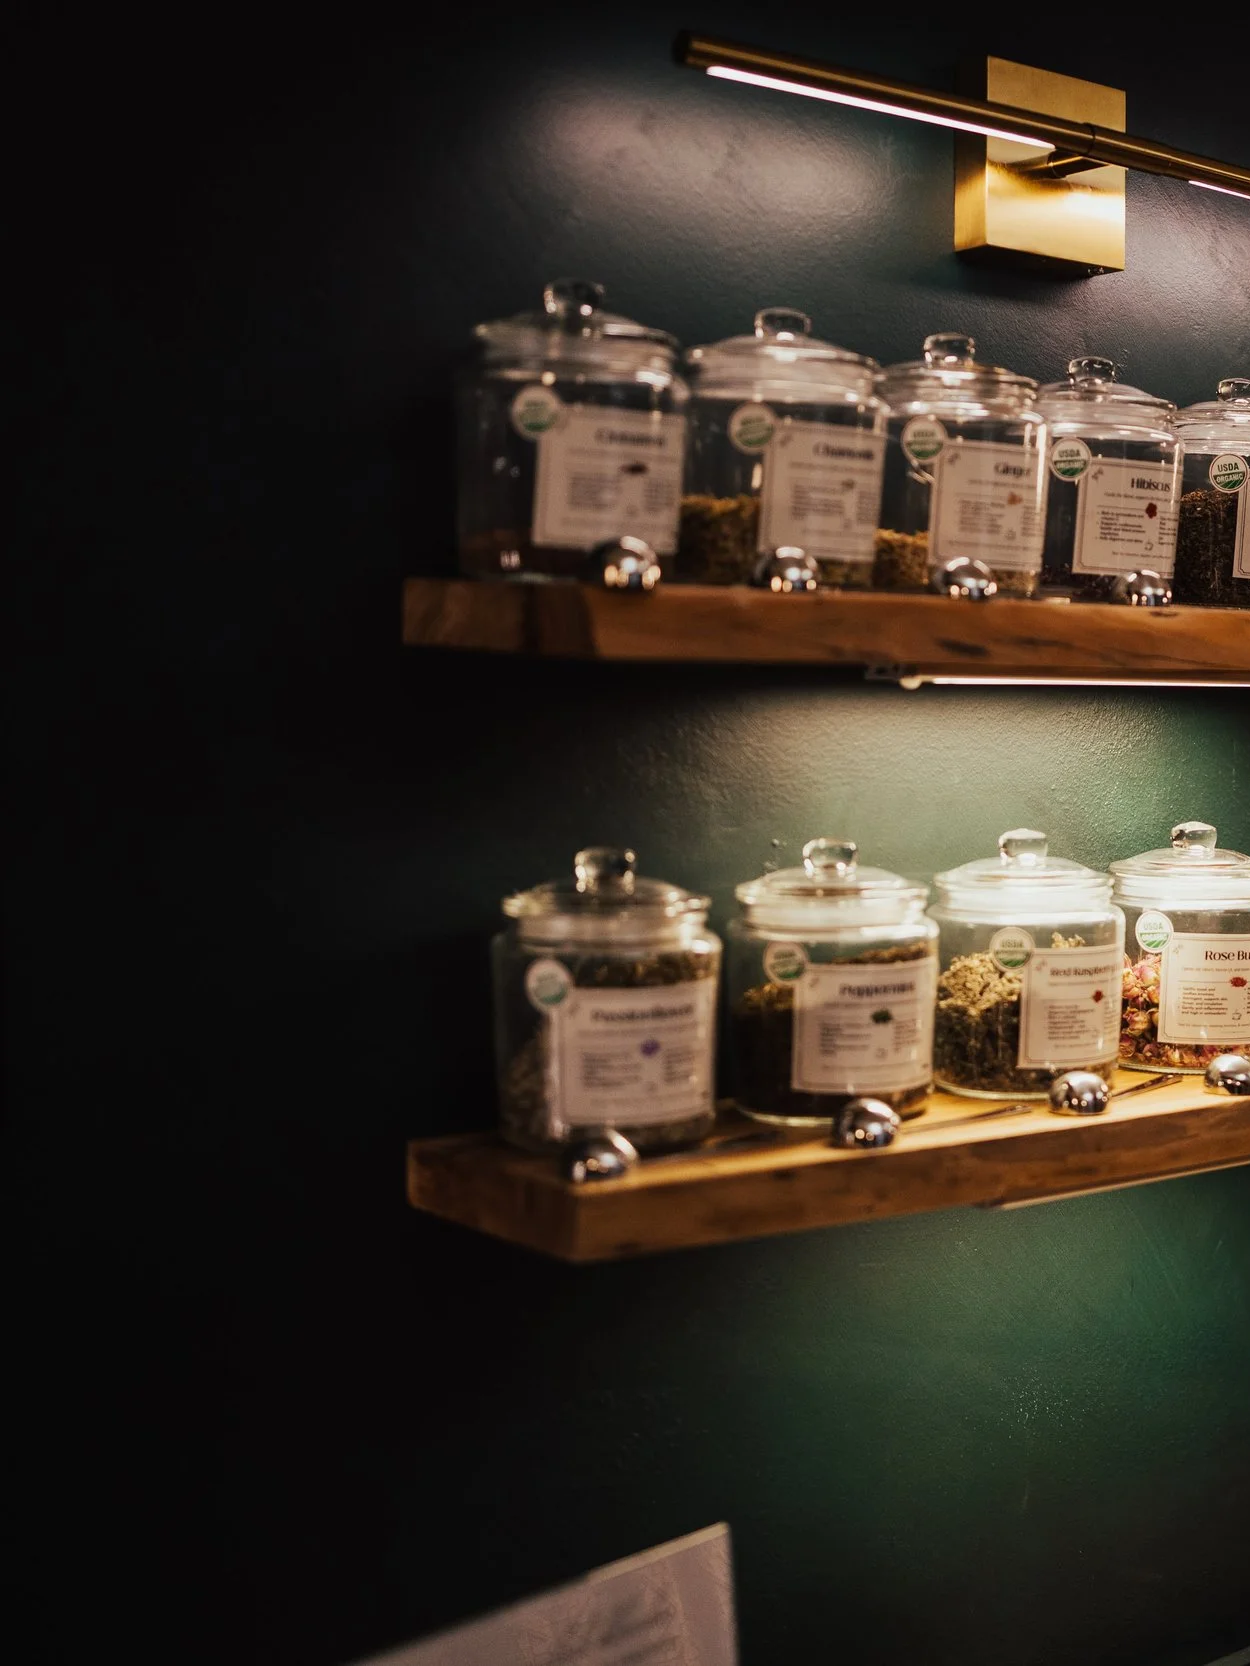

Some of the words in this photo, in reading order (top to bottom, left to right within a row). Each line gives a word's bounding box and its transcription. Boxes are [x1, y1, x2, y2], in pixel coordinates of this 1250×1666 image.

[1058, 449, 1081, 458] USDA
[1217, 462, 1239, 472] USDA
[1216, 473, 1243, 482] ORGANIC
[1131, 477, 1171, 492] Hibiscus
[1143, 922, 1164, 930] USDA
[1205, 950, 1235, 960] Rose
